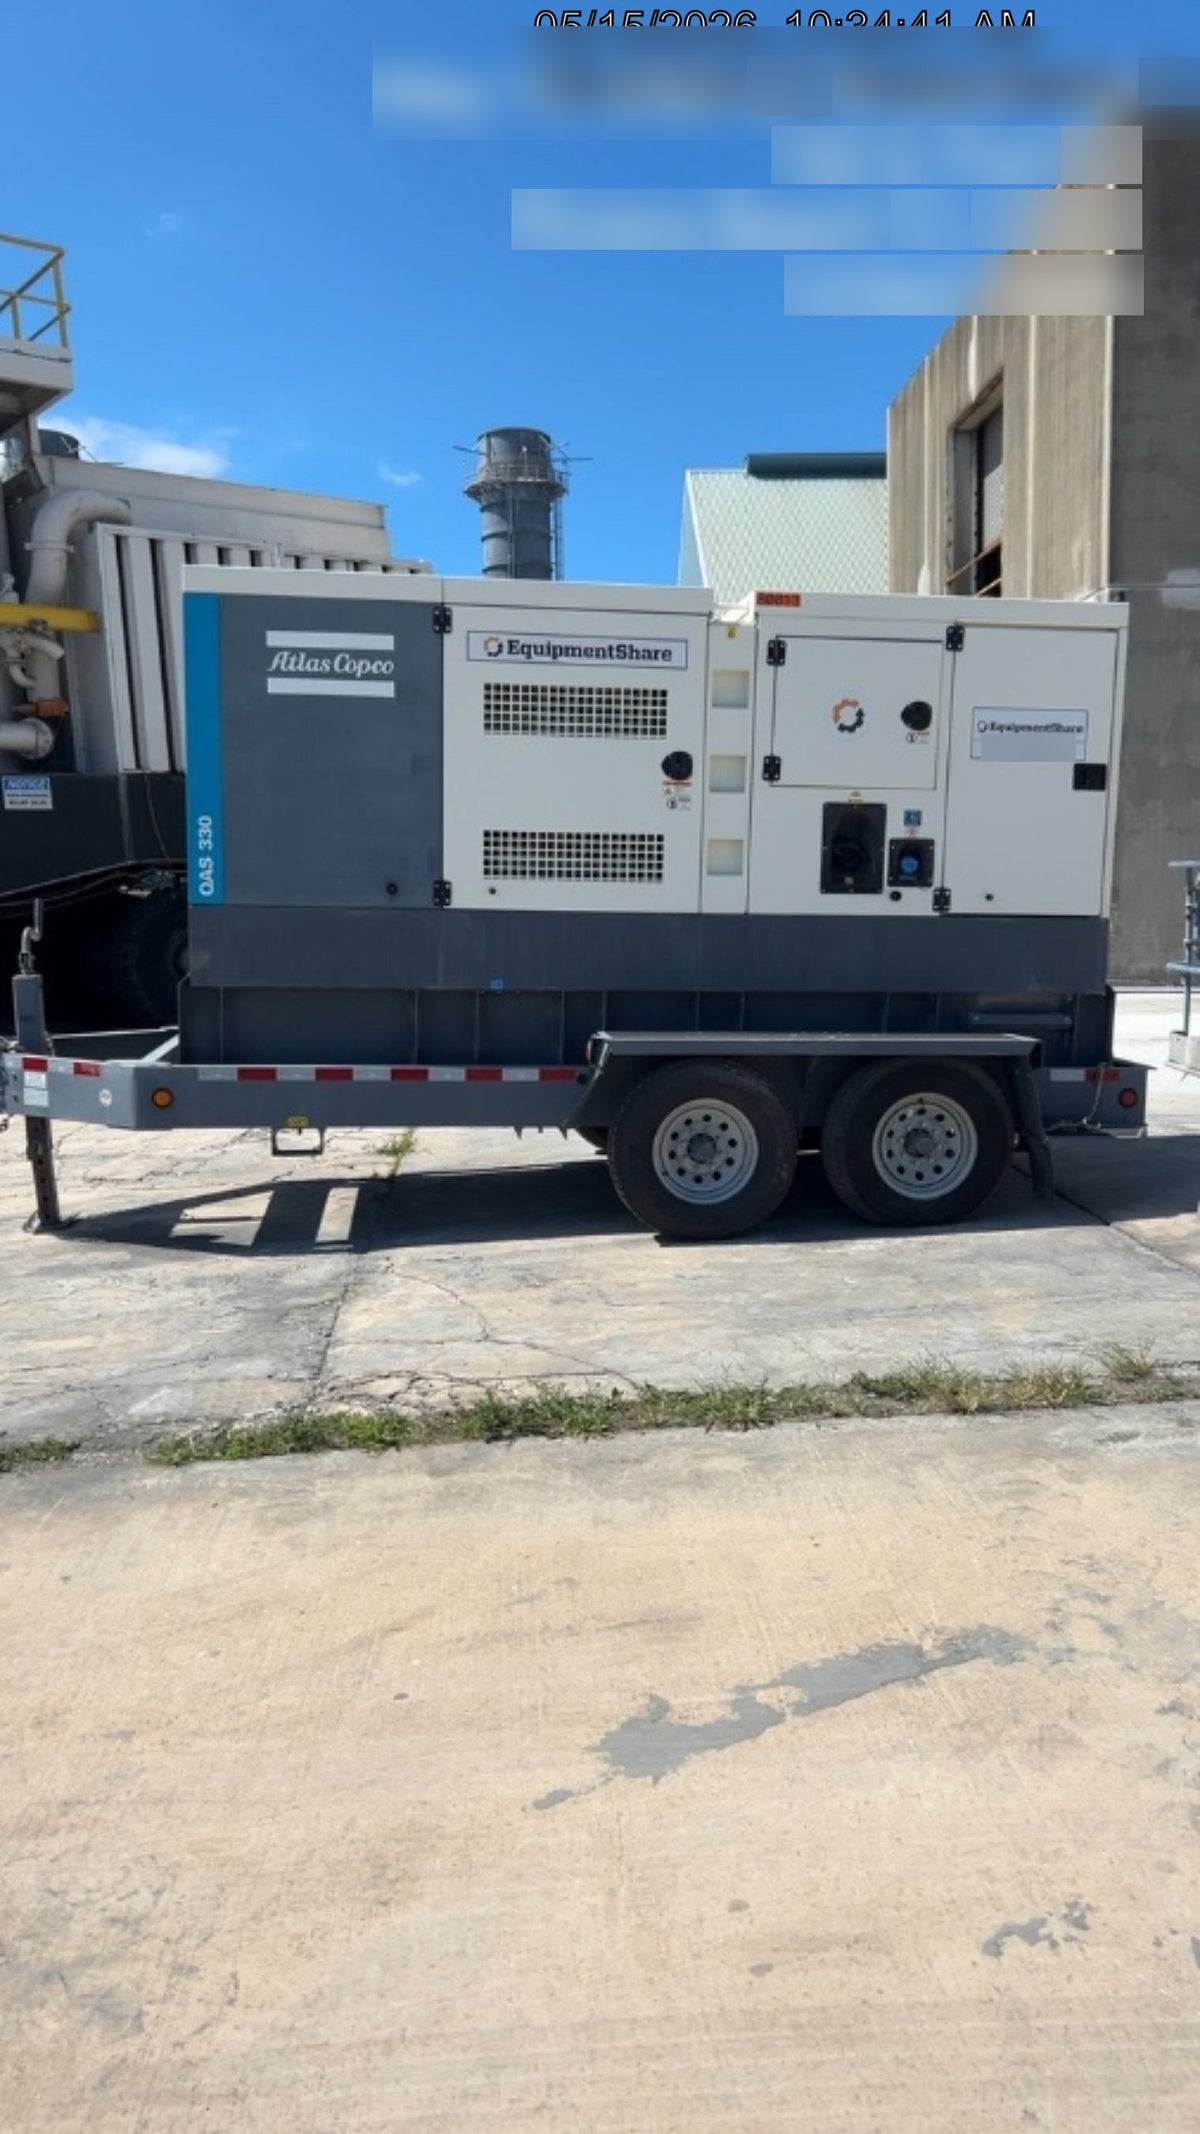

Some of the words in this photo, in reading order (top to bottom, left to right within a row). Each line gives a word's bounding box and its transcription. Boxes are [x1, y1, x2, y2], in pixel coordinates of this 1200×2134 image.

[506, 639, 672, 662] EquipmentShare
[267, 651, 330, 672] Atlas
[333, 652, 395, 678] Copco
[198, 815, 213, 850] 330
